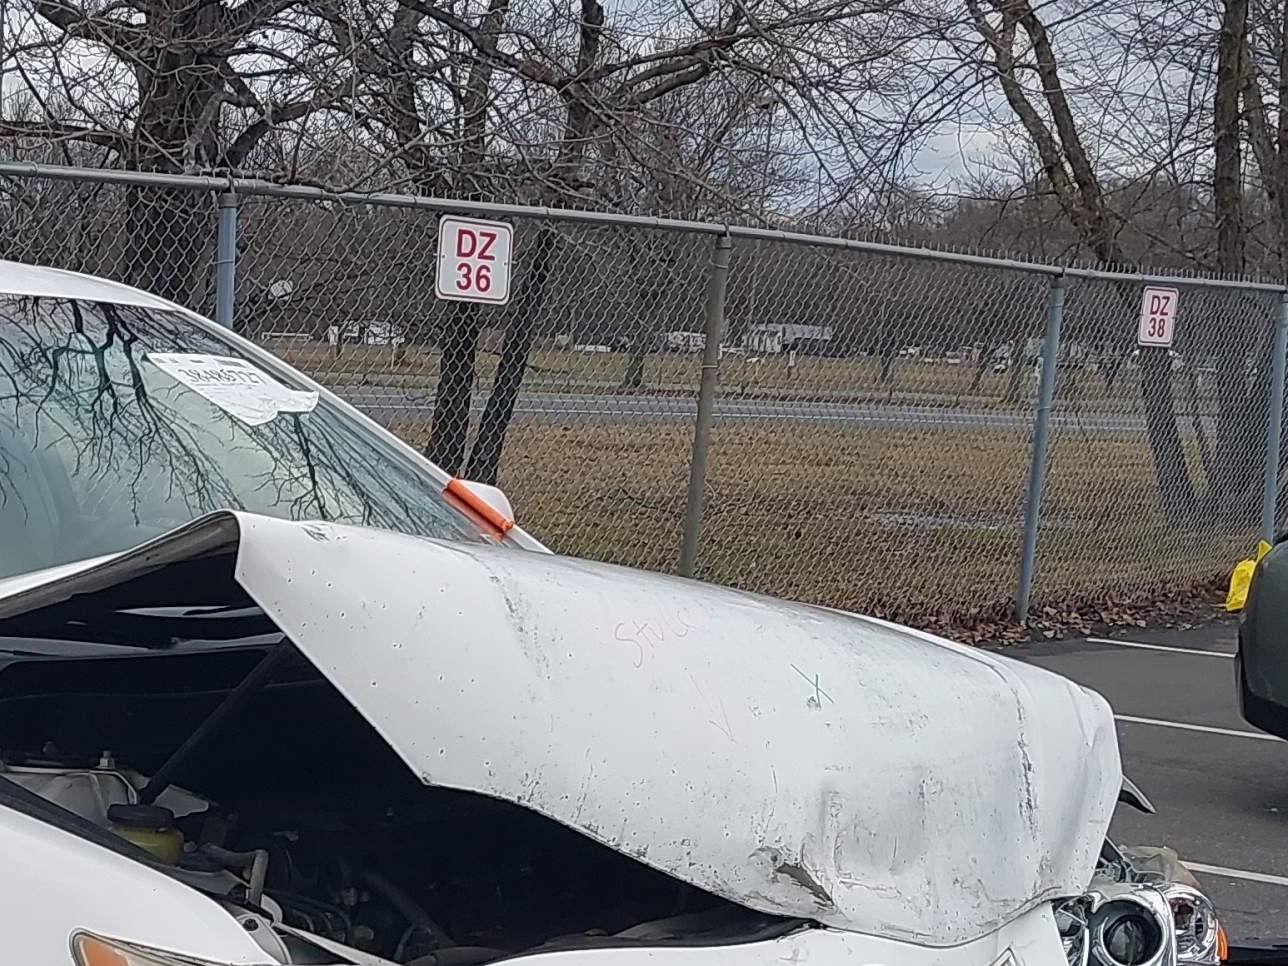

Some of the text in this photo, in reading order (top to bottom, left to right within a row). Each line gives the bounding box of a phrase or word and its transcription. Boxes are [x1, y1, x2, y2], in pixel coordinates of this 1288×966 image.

[456, 228, 497, 261] DZ
[456, 262, 491, 293] 36
[1149, 294, 1170, 316] DZ
[1148, 317, 1165, 338] 38
